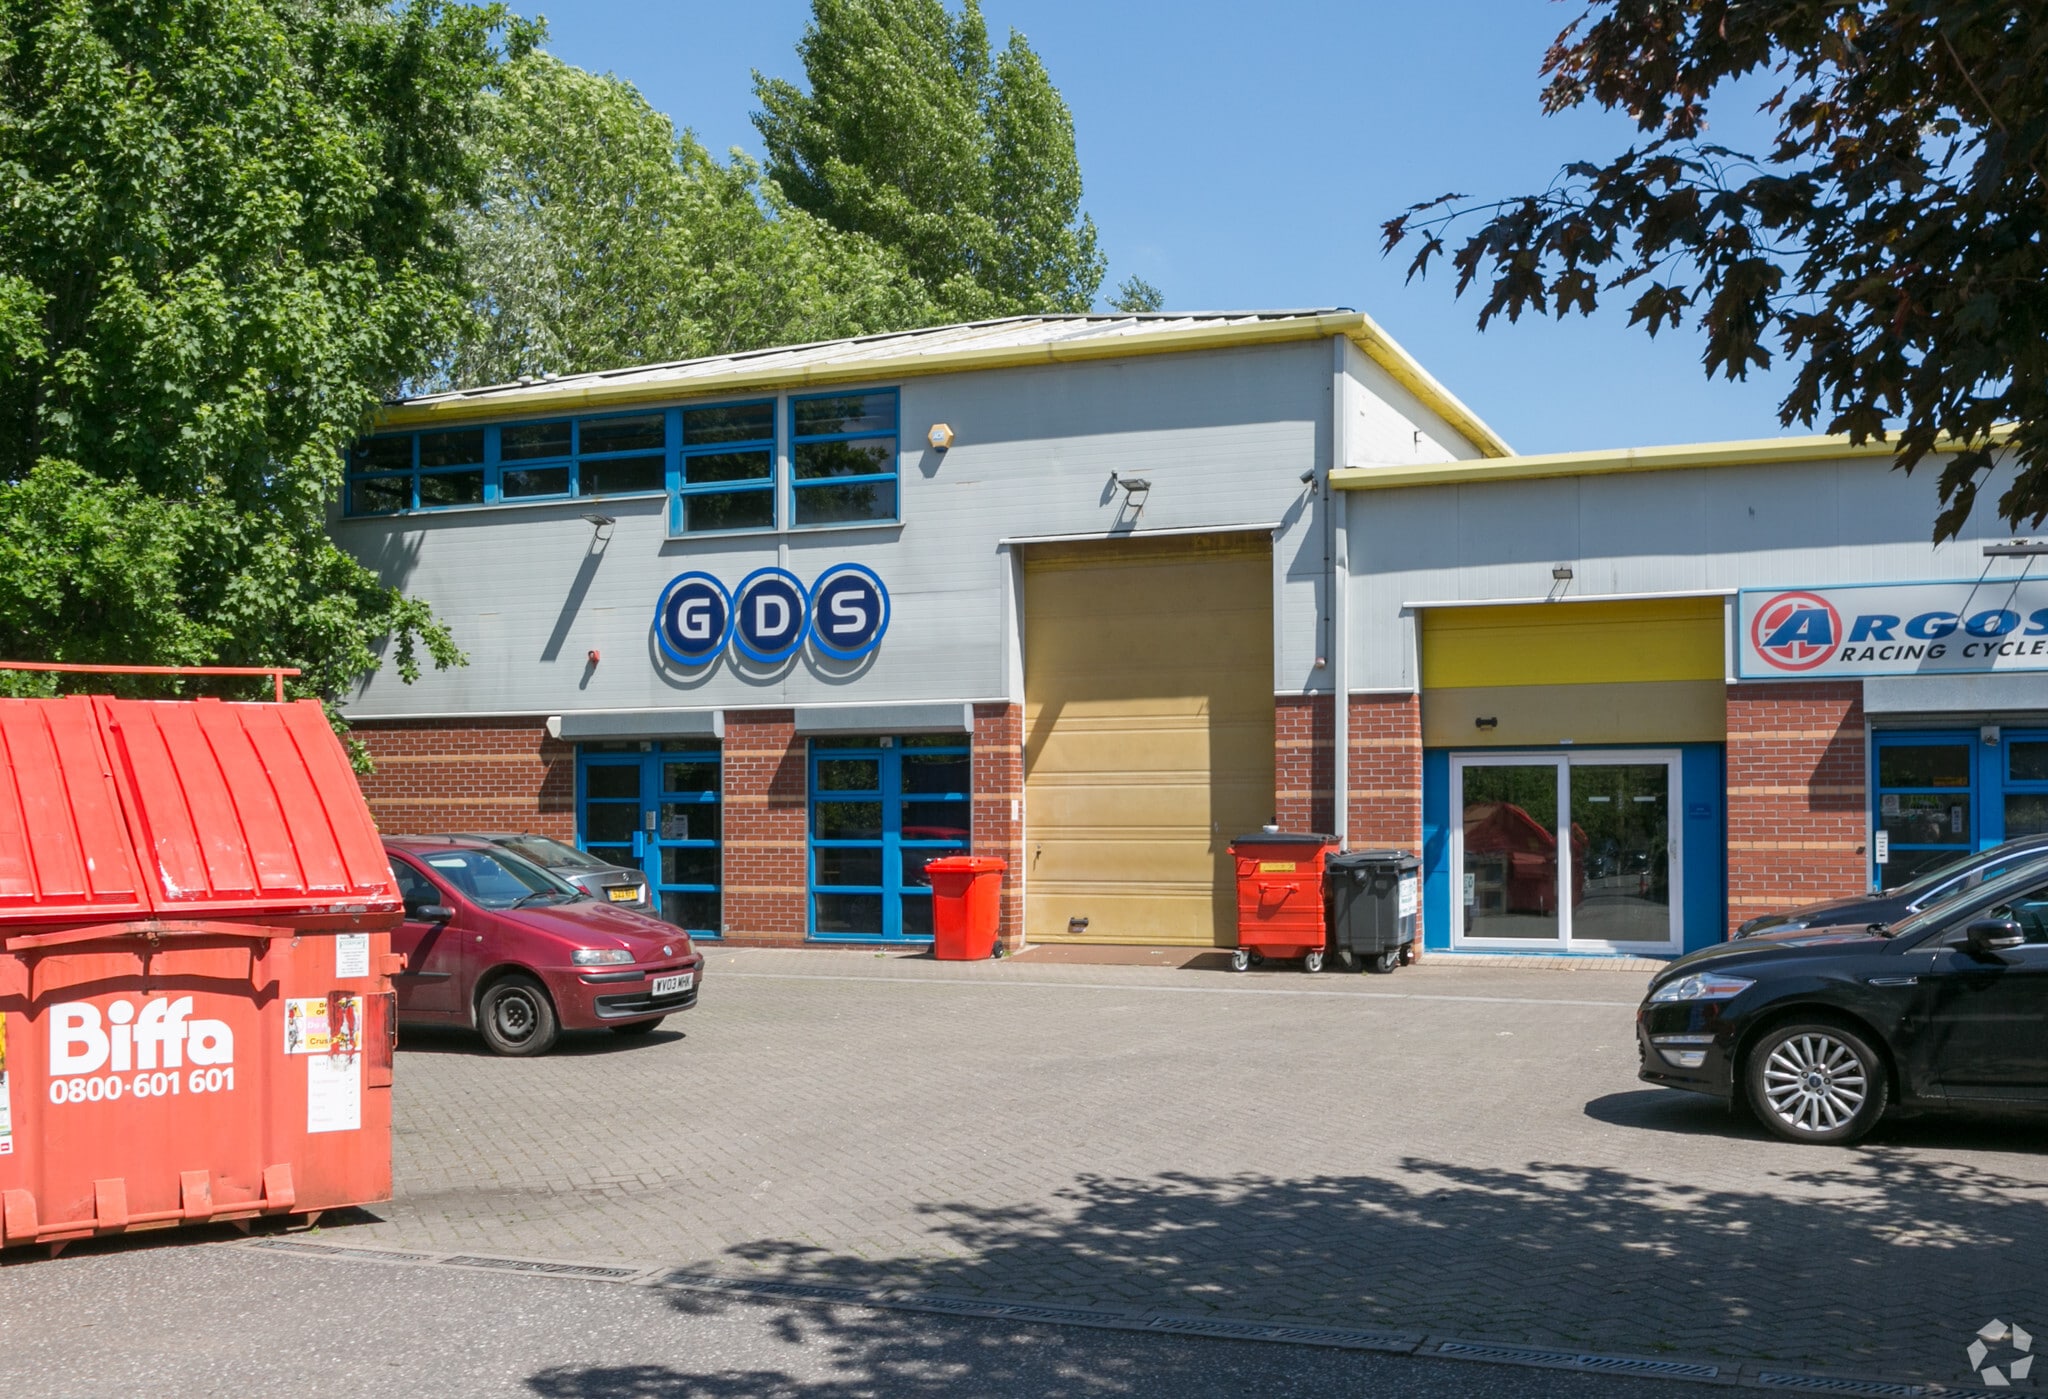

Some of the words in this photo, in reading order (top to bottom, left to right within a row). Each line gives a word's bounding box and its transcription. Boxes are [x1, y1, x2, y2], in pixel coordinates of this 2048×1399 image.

[677, 590, 867, 639] GDS
[1840, 643, 1947, 662] RACING
[1962, 640, 2048, 659] CYCLE
[656, 977, 677, 992] WV03
[50, 996, 233, 1076] Biffa
[189, 1067, 234, 1093] 601
